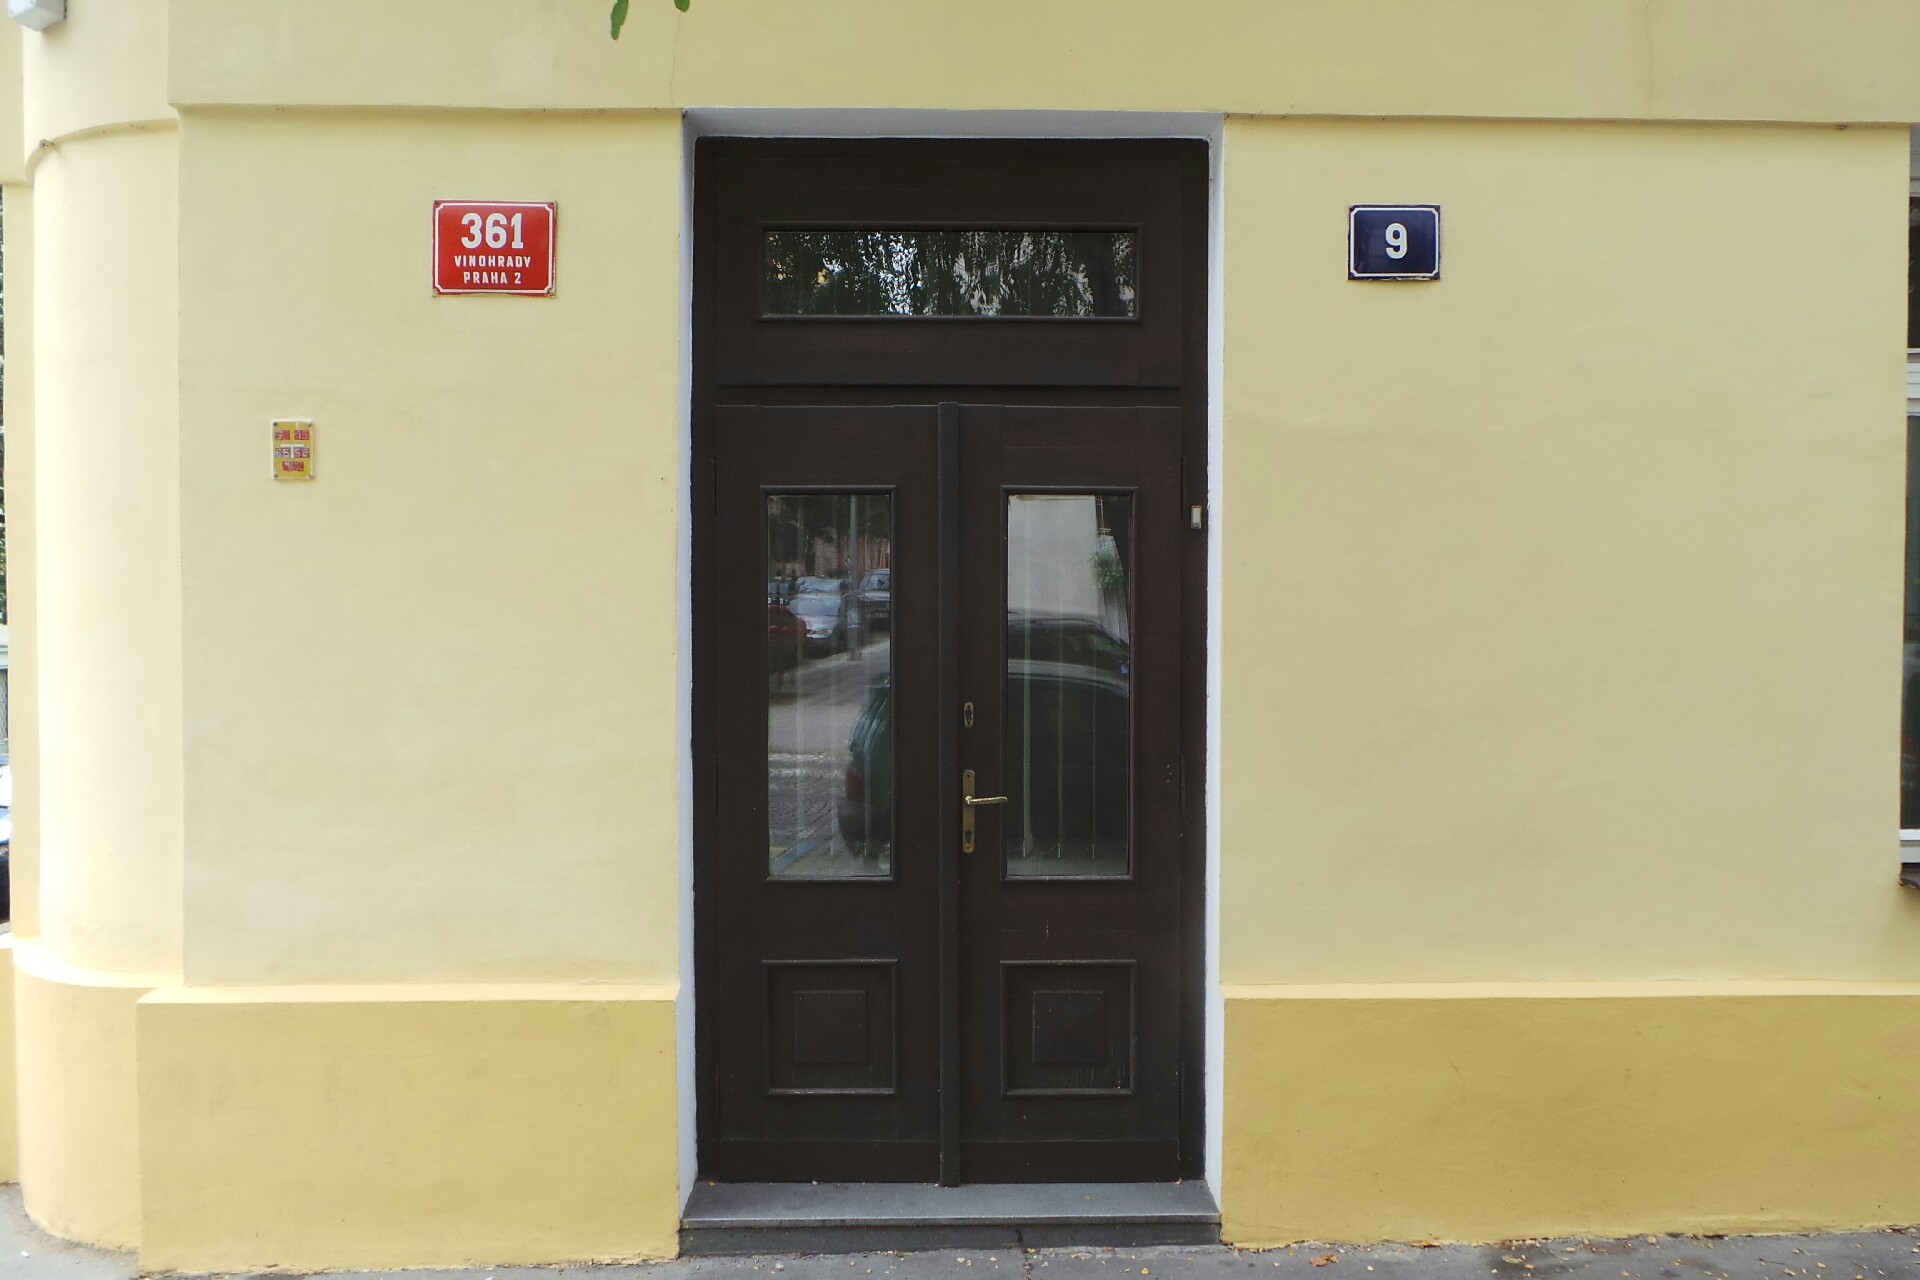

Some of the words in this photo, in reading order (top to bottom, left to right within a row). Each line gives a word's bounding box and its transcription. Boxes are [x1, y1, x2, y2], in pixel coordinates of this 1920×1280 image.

[461, 212, 524, 249] 361
[1385, 222, 1408, 259] 9
[454, 255, 532, 268] VINOHRADY
[463, 271, 508, 284] PRAHA
[513, 271, 522, 284] 2
